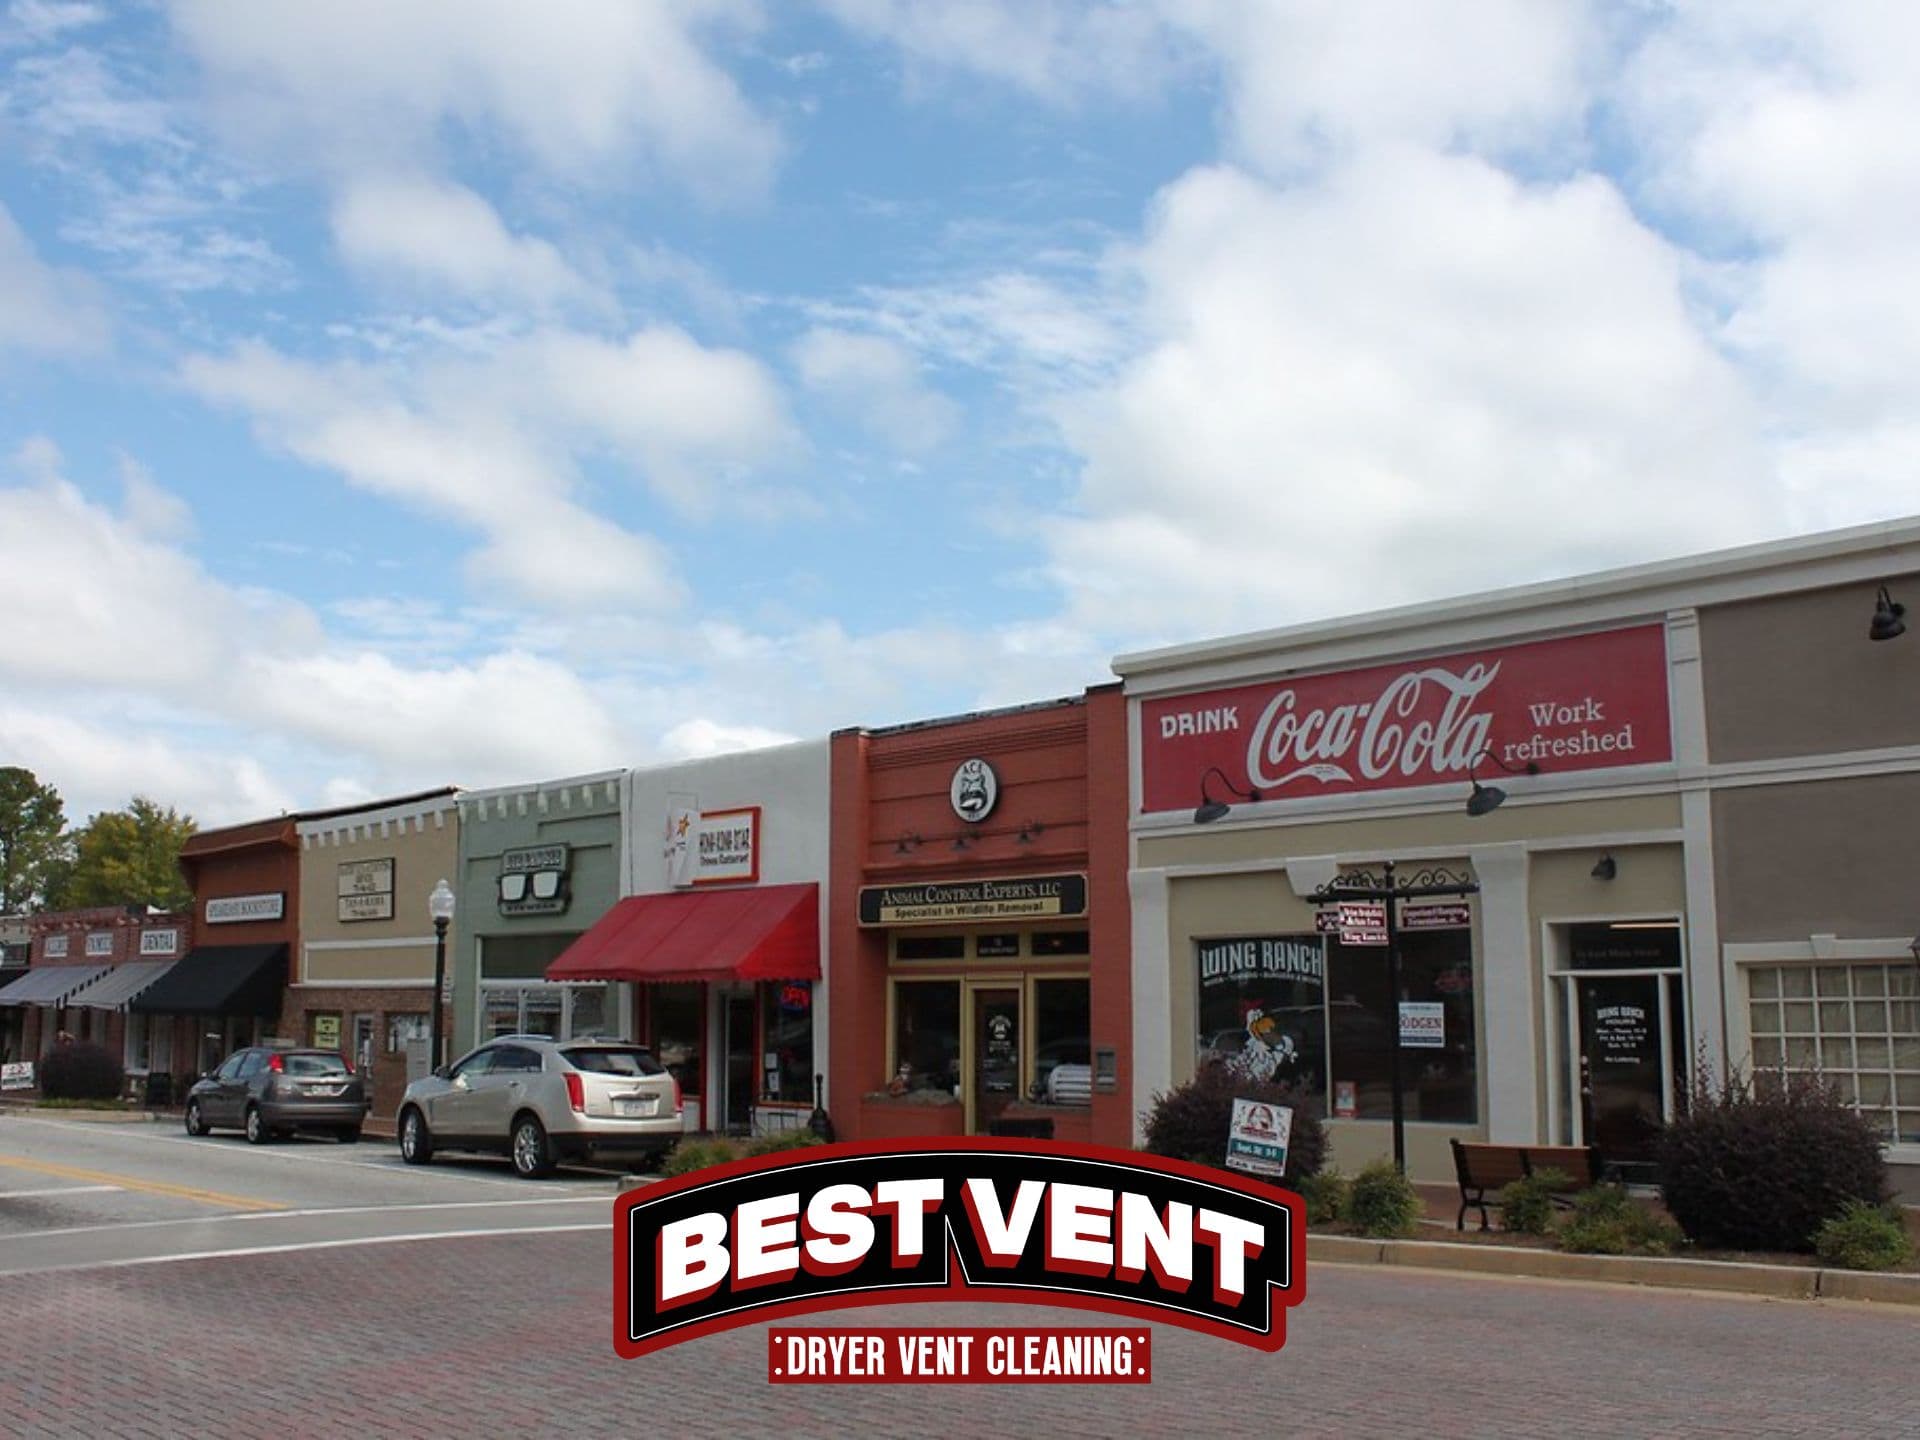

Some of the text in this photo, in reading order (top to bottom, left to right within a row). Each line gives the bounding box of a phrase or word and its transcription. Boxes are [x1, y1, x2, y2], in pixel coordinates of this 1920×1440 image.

[1160, 659, 1501, 789] DRINK Coca-Cola
[1528, 698, 1604, 727] Work
[1503, 725, 1634, 762] refreshed
[925, 885, 979, 904] CONTROL
[1039, 882, 1062, 897] LLC
[895, 907, 943, 919] Specialist
[956, 904, 994, 915] Wildlife
[998, 901, 1043, 913] Removal
[1201, 941, 1322, 978] WING RANCH
